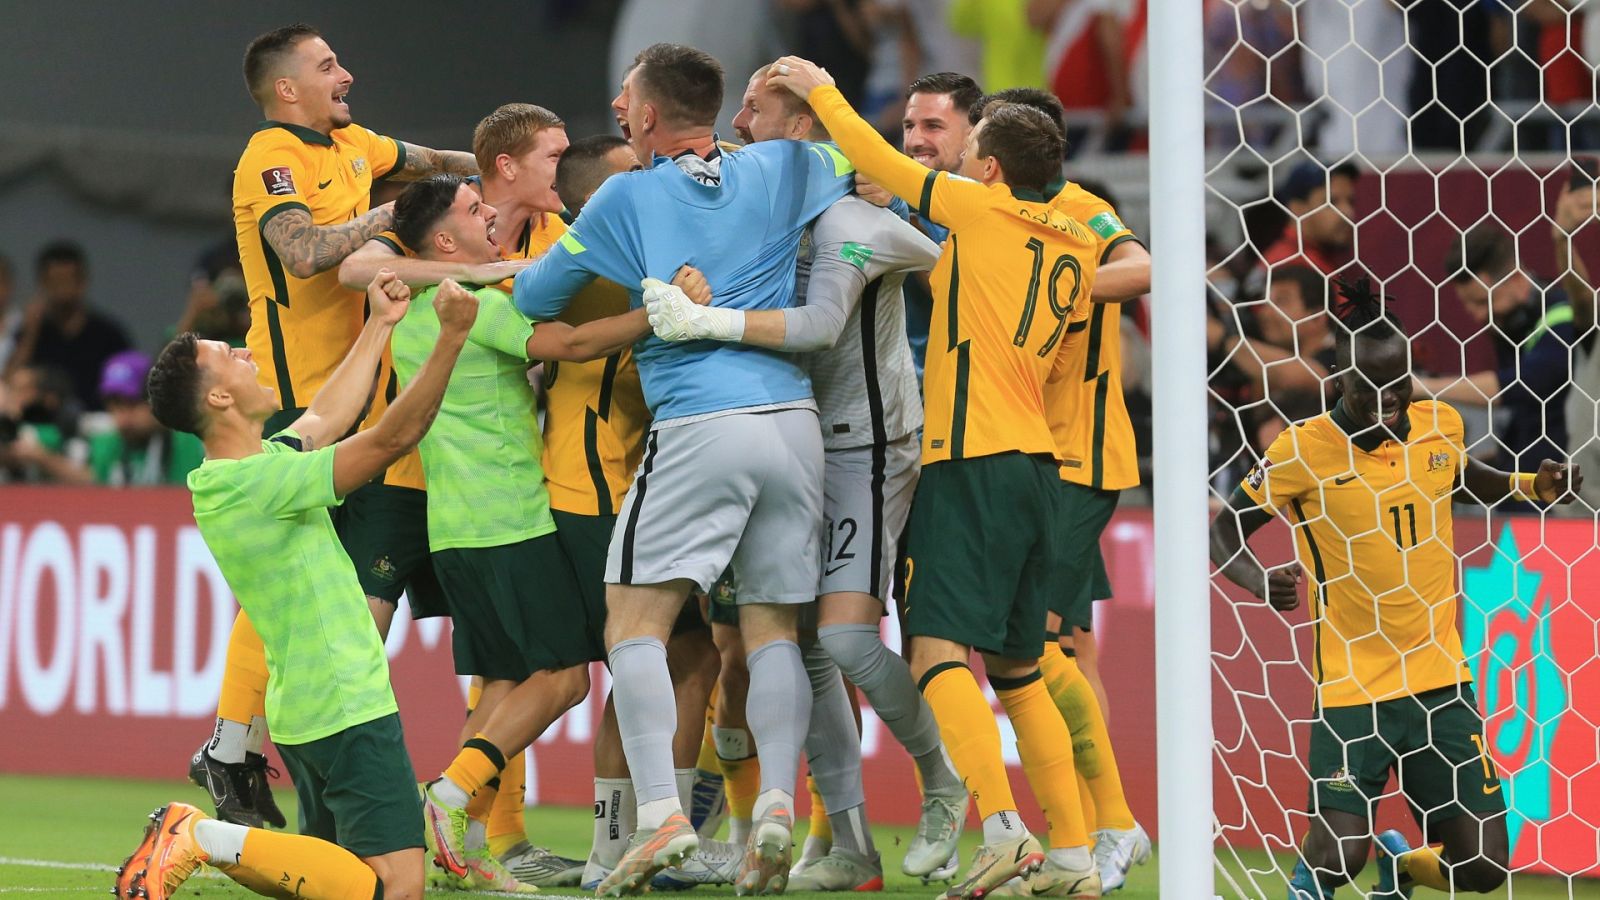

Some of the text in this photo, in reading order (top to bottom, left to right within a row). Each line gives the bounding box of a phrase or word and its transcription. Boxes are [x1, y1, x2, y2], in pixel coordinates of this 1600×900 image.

[663, 290, 685, 322] ONE
[1012, 236, 1081, 358] 19
[827, 517, 857, 563] 12
[1389, 503, 1418, 552] 11
